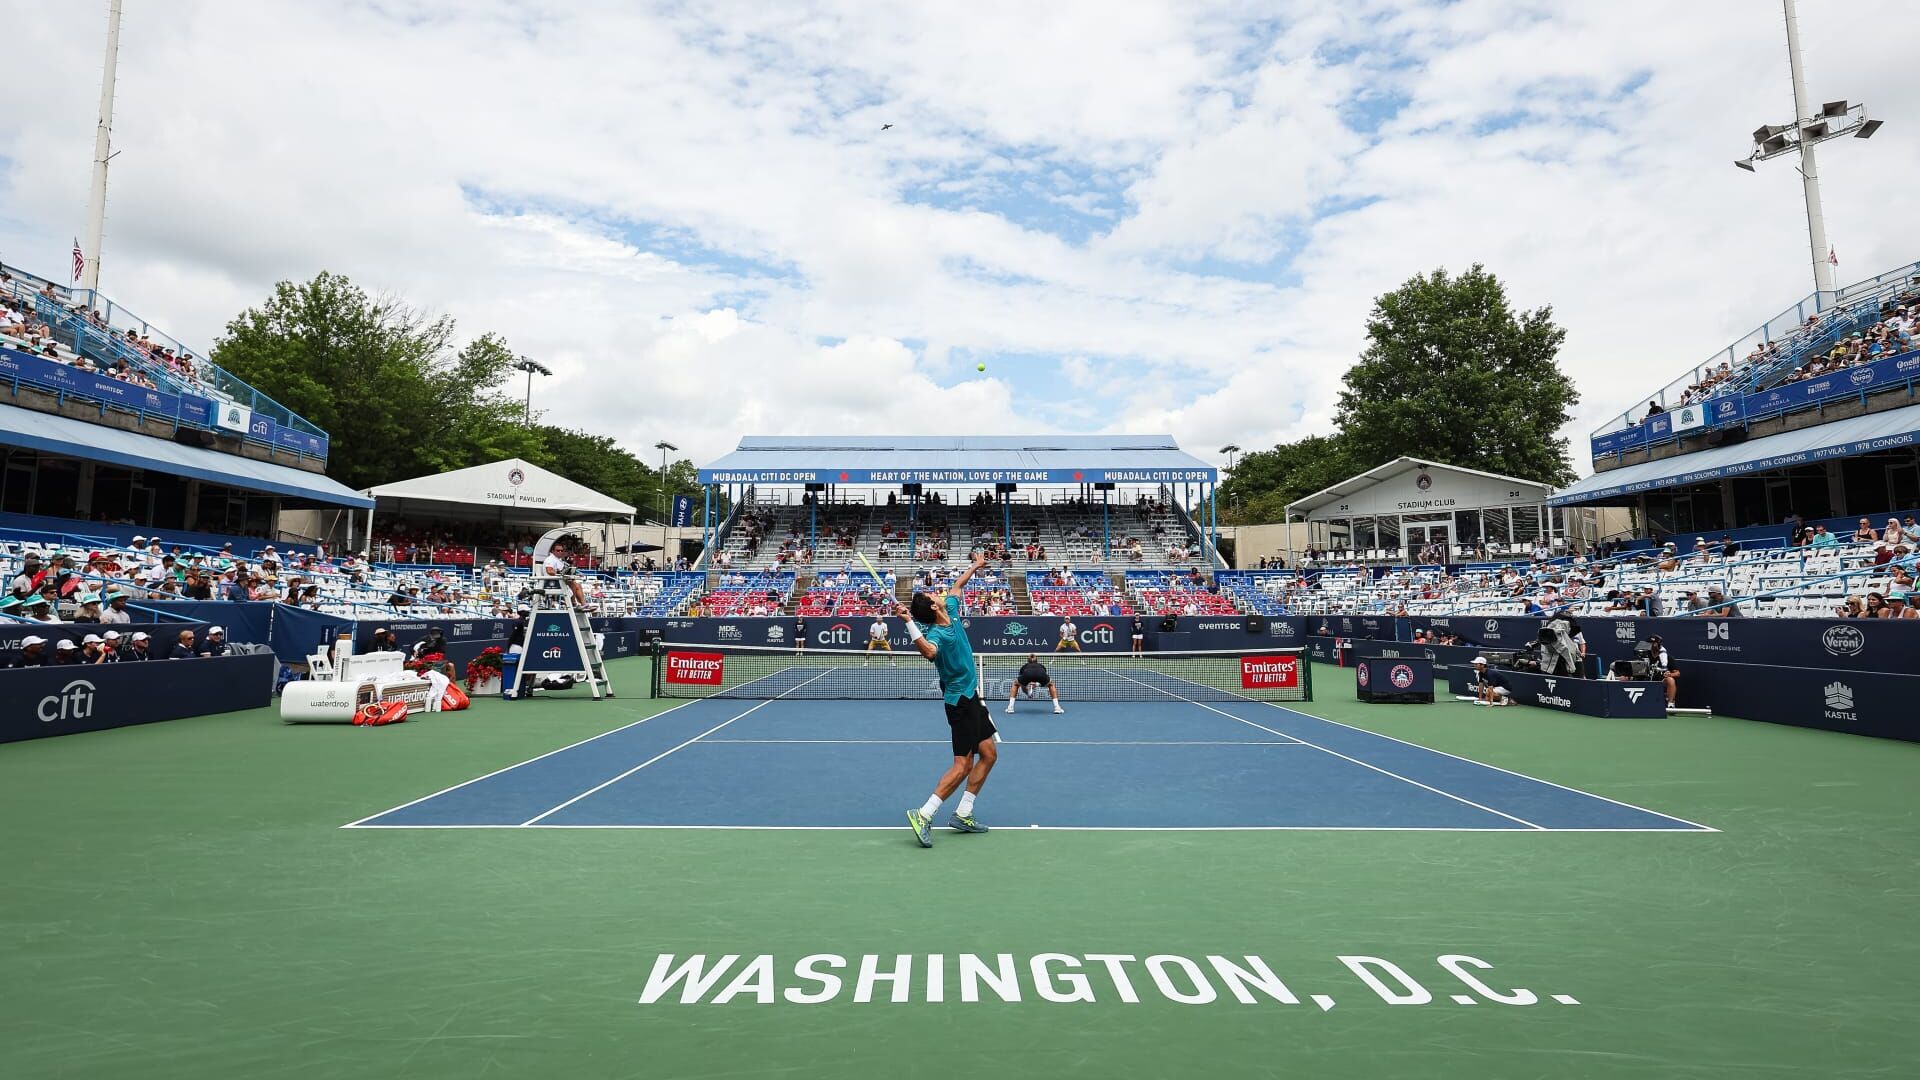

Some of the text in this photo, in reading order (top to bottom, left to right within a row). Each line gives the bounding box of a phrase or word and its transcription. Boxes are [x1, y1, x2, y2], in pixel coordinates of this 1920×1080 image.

[43, 374, 77, 386] MUBADALA
[252, 421, 268, 435] citi
[1854, 434, 1913, 451] 1978 CONNORS
[1813, 446, 1847, 459] 1977 VILAS
[1773, 453, 1807, 465] CONNORS
[712, 472, 816, 482] MUBADALA CITI DC OPEN
[870, 472, 1048, 482] HEART OF THE NATION, LOVE OF THE GAME
[1104, 472, 1208, 481] MUBADALA CITI DC OPEN
[1398, 499, 1456, 509] STADIUM CLUB
[818, 624, 852, 644] citi
[1081, 624, 1114, 644] citi
[1616, 628, 1636, 639] ONE
[1826, 636, 1859, 648] Veroni
[542, 646, 561, 658] citi
[670, 657, 720, 670] Emirates
[1244, 662, 1294, 674] Emirates
[676, 670, 712, 680] FLY BETTER
[1252, 673, 1287, 683] FLY BETTER
[38, 680, 97, 722] citi
[388, 689, 430, 704] waterdrop
[1536, 693, 1572, 708] Tecnifibre
[310, 700, 350, 708] waterdrop
[1824, 710, 1858, 720] KASTLE
[638, 953, 1581, 1011] WASHINGTON, D.C.
